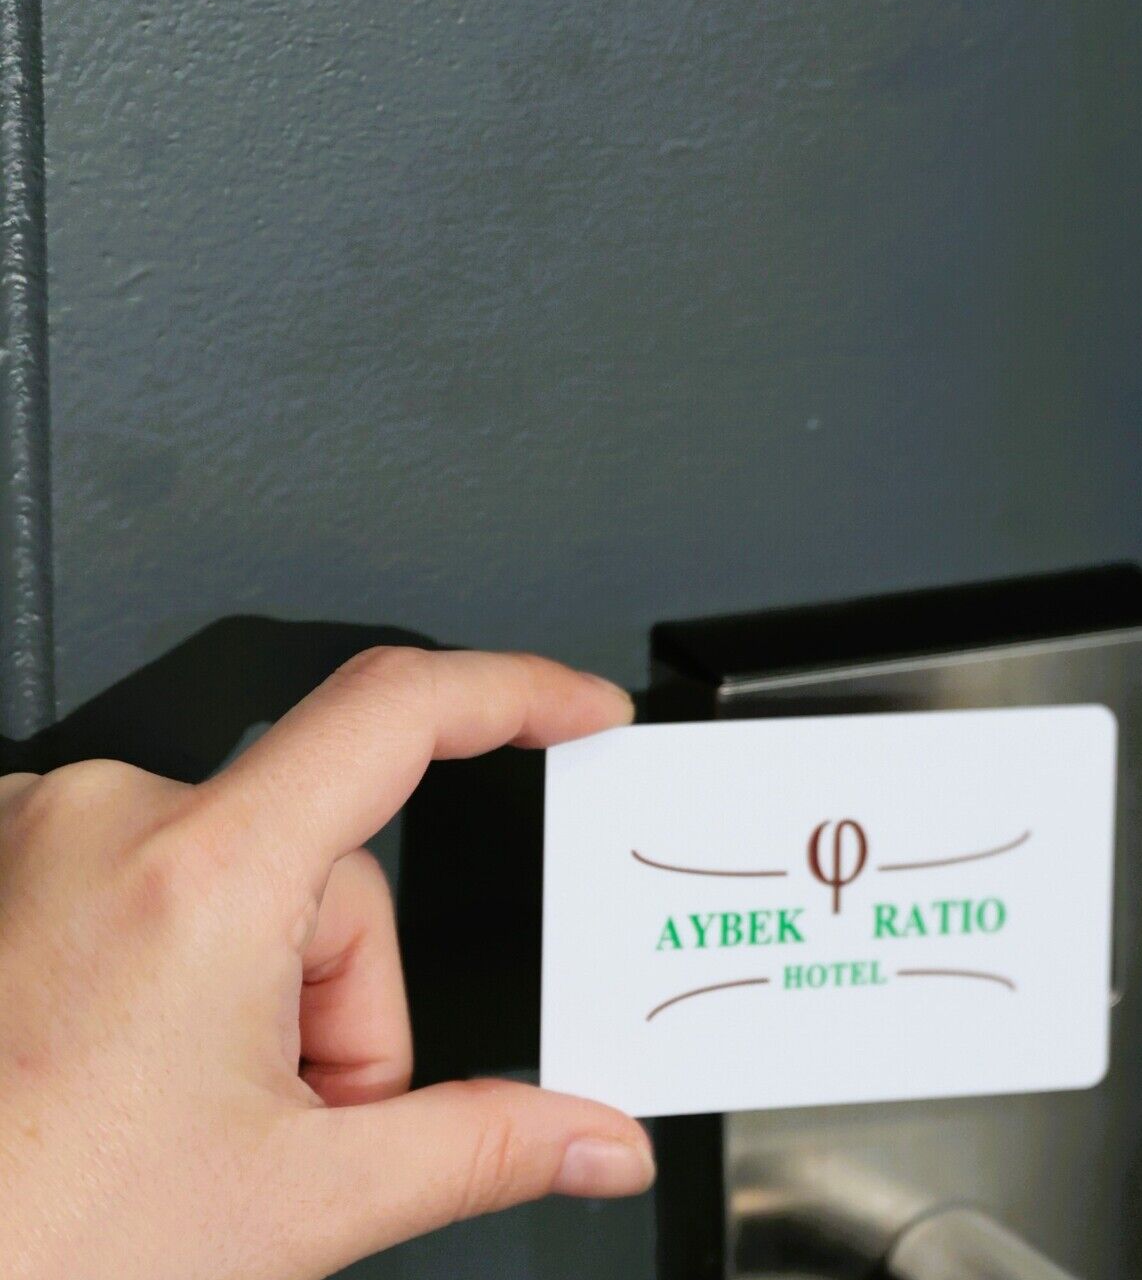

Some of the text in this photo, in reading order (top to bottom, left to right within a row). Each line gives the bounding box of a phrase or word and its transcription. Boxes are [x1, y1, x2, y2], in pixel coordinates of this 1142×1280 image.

[656, 898, 1007, 950] AYBEK RATIO
[783, 961, 887, 989] HOTEL
